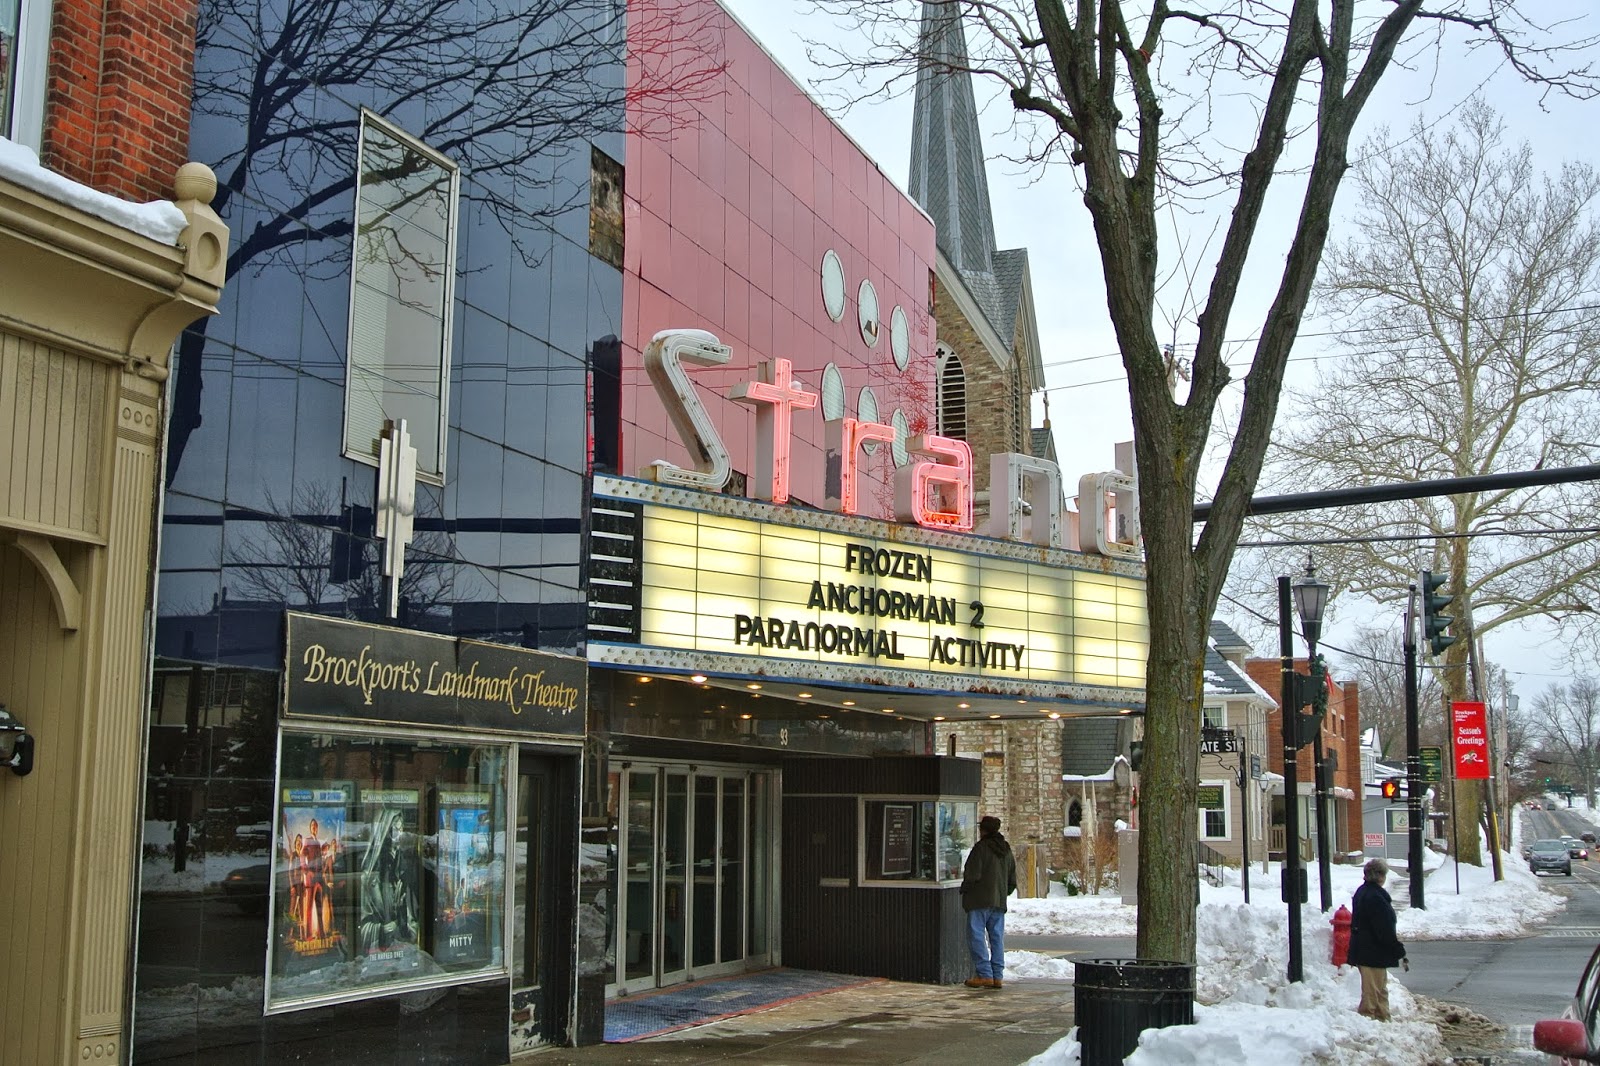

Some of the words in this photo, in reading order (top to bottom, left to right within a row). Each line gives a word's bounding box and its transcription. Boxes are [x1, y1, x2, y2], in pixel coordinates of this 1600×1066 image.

[845, 542, 932, 583] FROZEN
[806, 580, 956, 626] ANCHORMAN
[969, 600, 985, 629] 2
[734, 614, 905, 661] PARANORMAL
[929, 635, 1025, 672] ACTIVITY
[303, 643, 422, 705] Brockport's
[423, 660, 522, 715] Landmark
[520, 669, 579, 711] Theatre
[780, 728, 788, 745] 93
[1457, 736, 1485, 746] Greetings
[1458, 726, 1482, 735] Season's
[1201, 741, 1220, 752] ATE
[449, 935, 472, 948] MITTY
